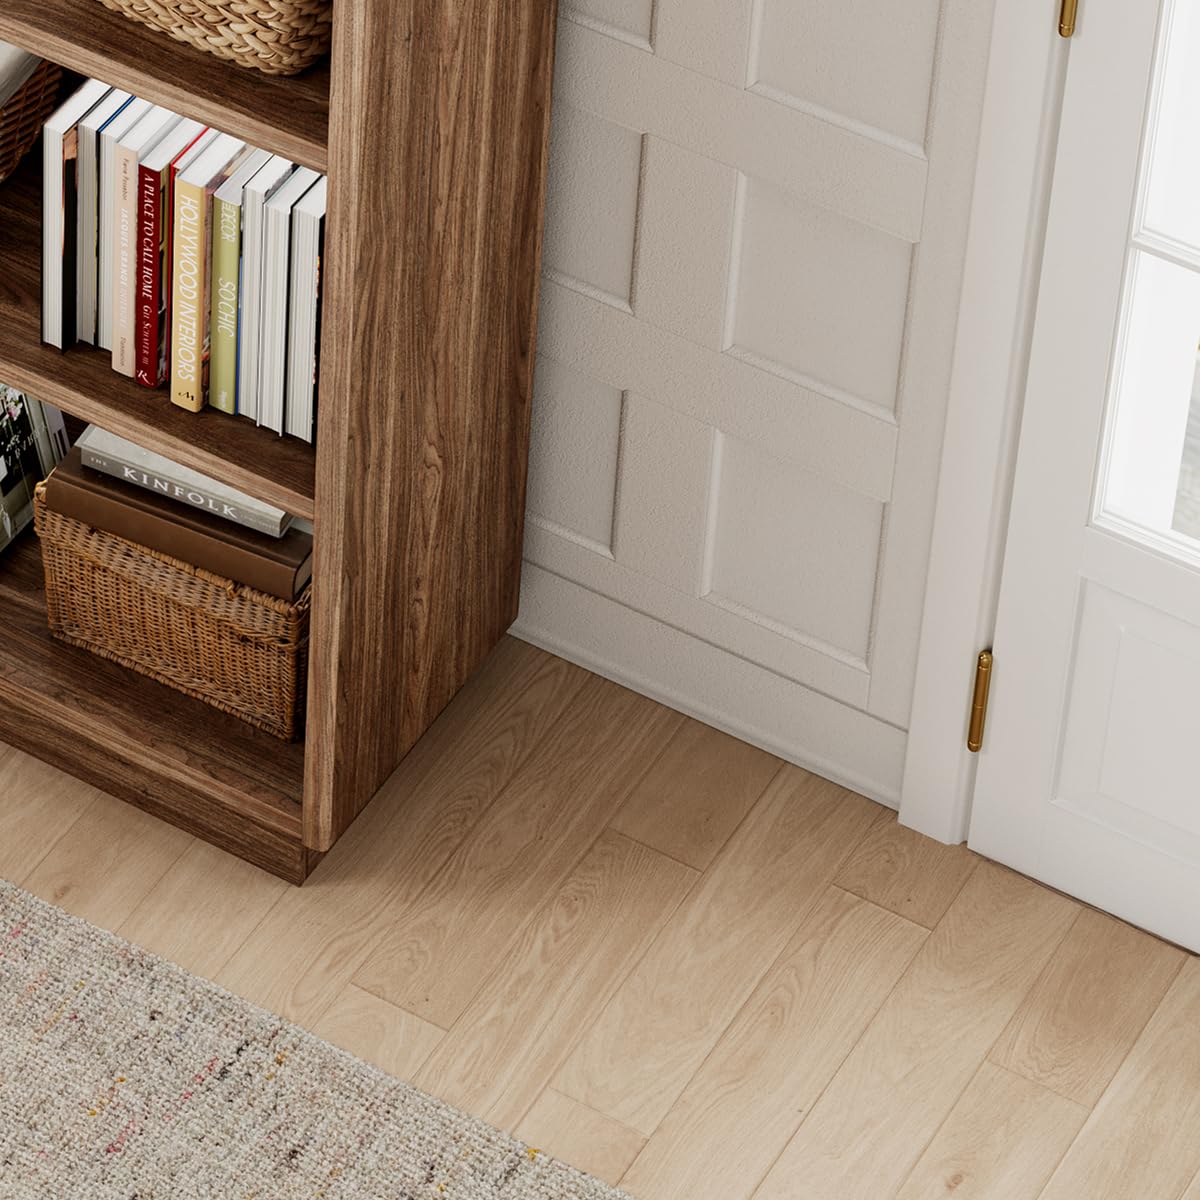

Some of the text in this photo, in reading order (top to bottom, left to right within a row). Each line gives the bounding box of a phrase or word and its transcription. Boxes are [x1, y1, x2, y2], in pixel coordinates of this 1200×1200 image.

[142, 173, 155, 300] A PLACE TO CALL HOME
[178, 195, 199, 382] HOLLYWOOD INTERIORS
[218, 278, 236, 337] SO CHIC
[90, 457, 240, 520] THE KINFOLK
